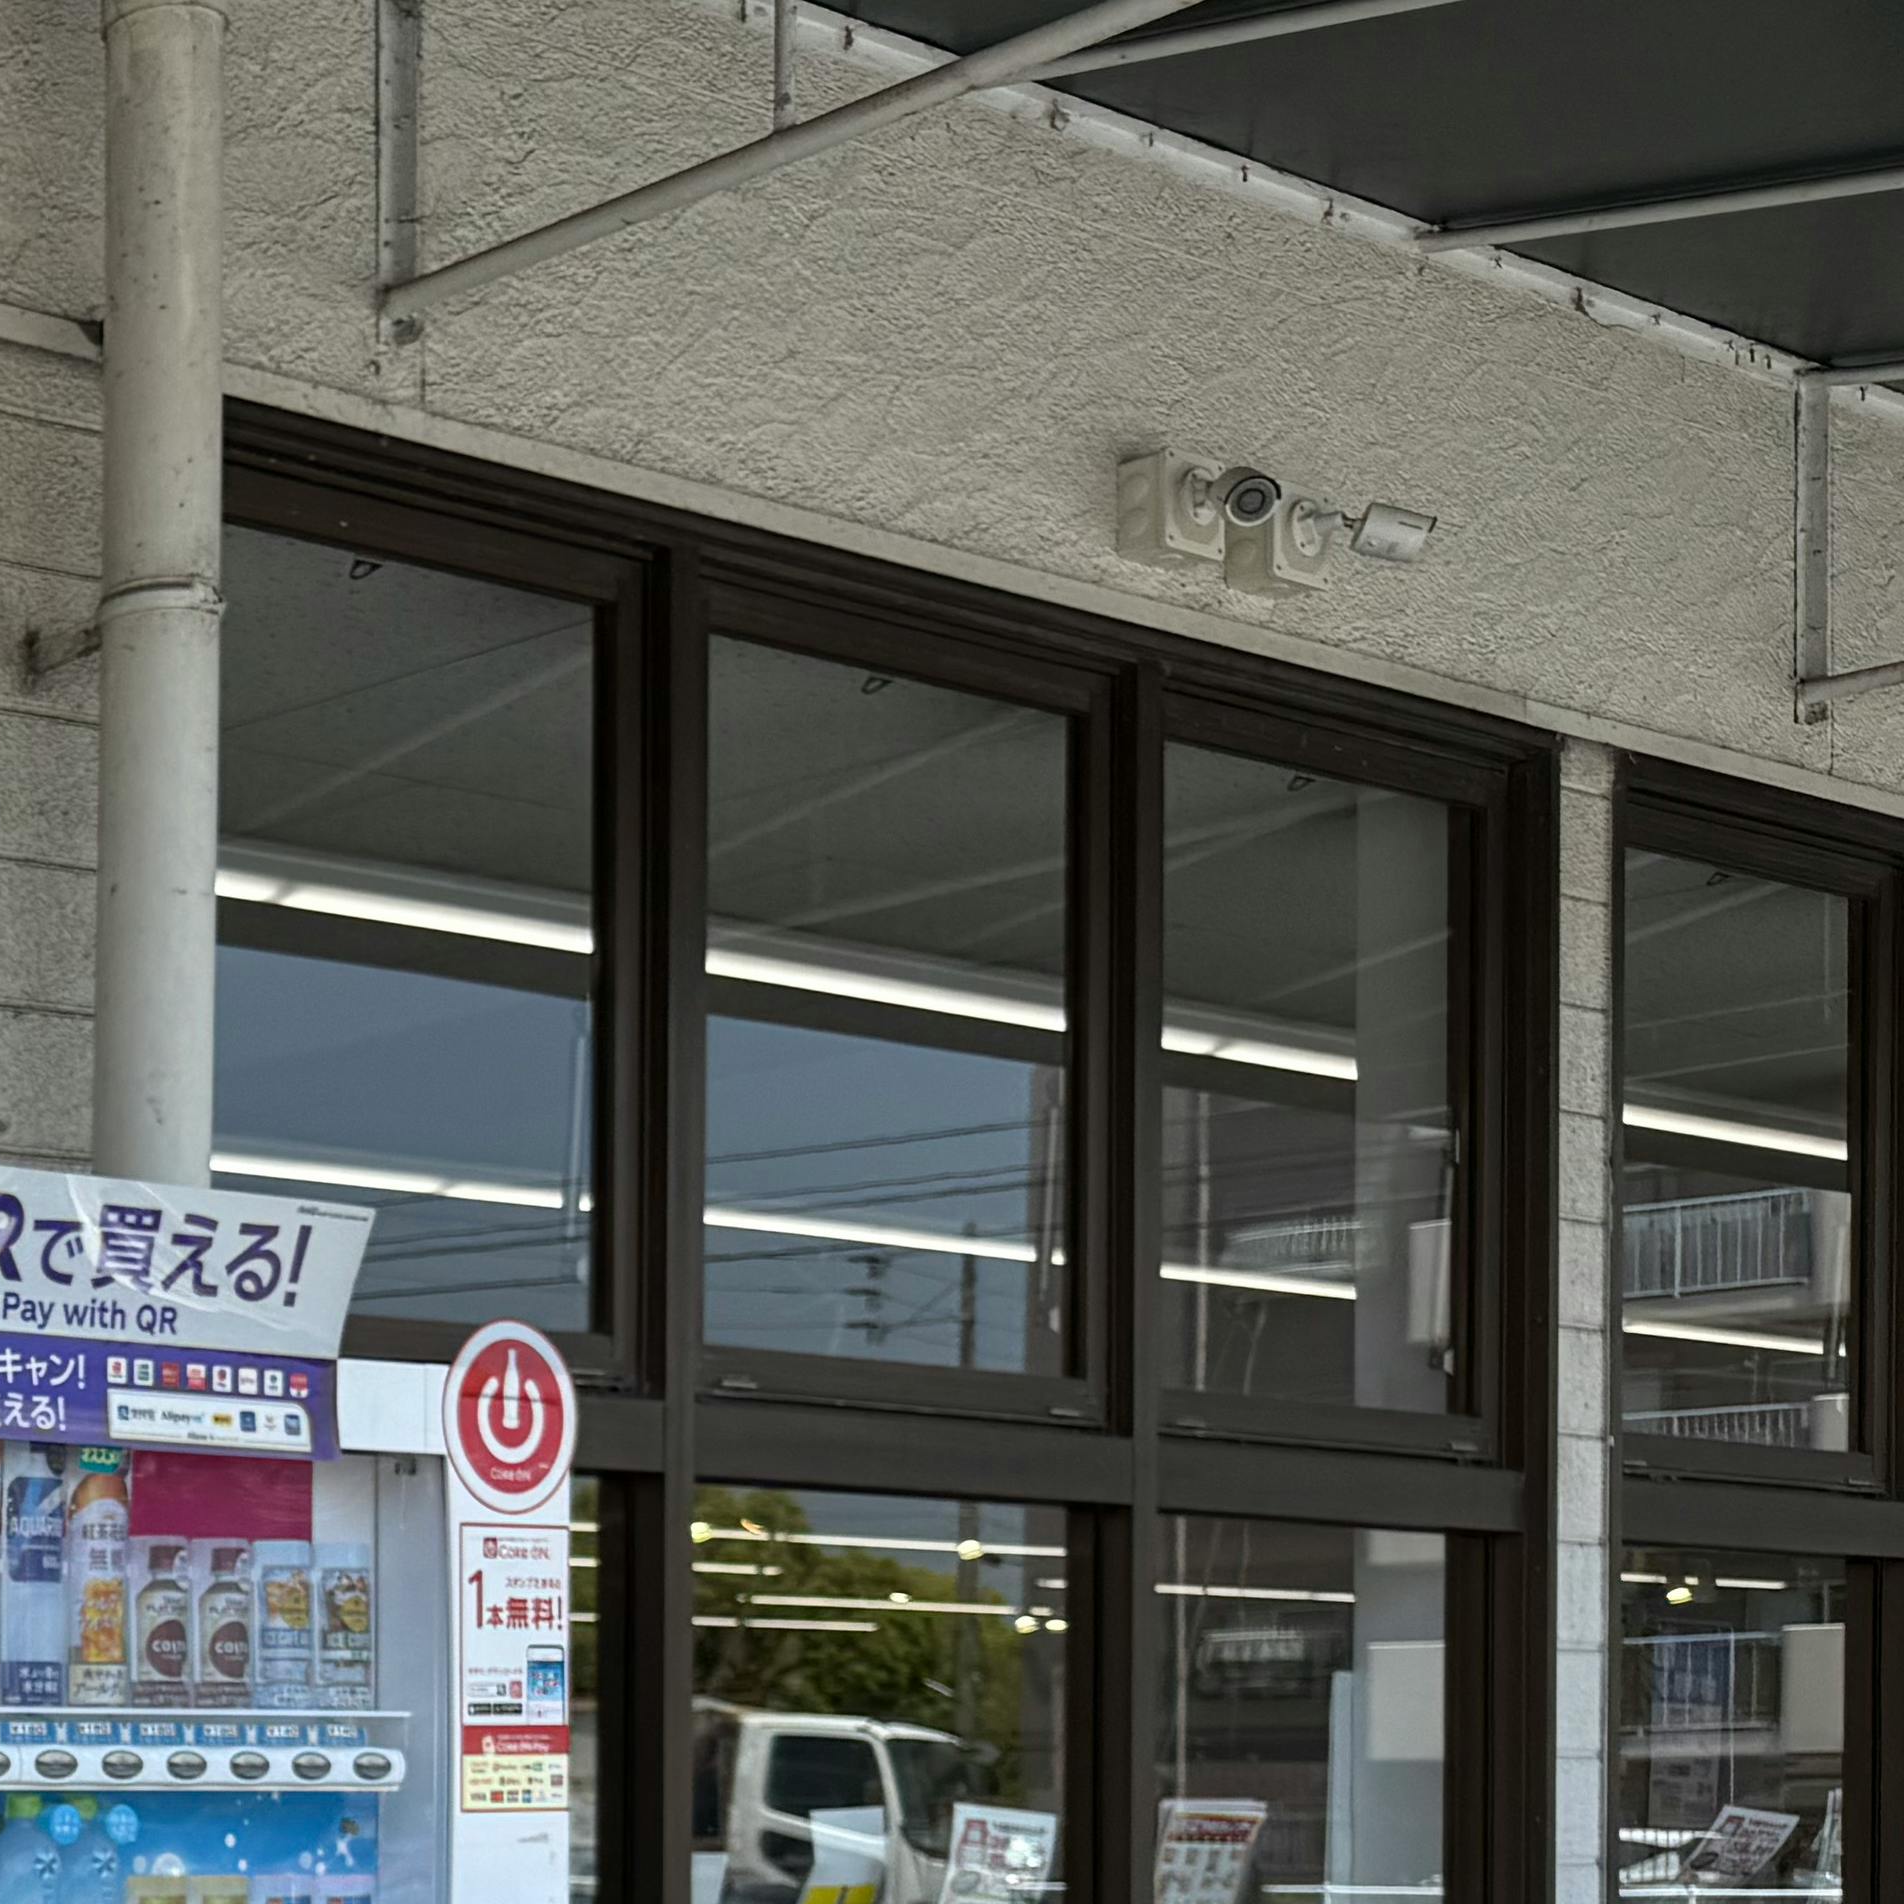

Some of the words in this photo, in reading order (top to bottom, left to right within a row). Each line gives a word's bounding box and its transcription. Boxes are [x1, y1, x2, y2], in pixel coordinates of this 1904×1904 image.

[1, 1291, 56, 1329] Pay
[62, 1295, 126, 1332] with
[135, 1305, 178, 1336] QR
